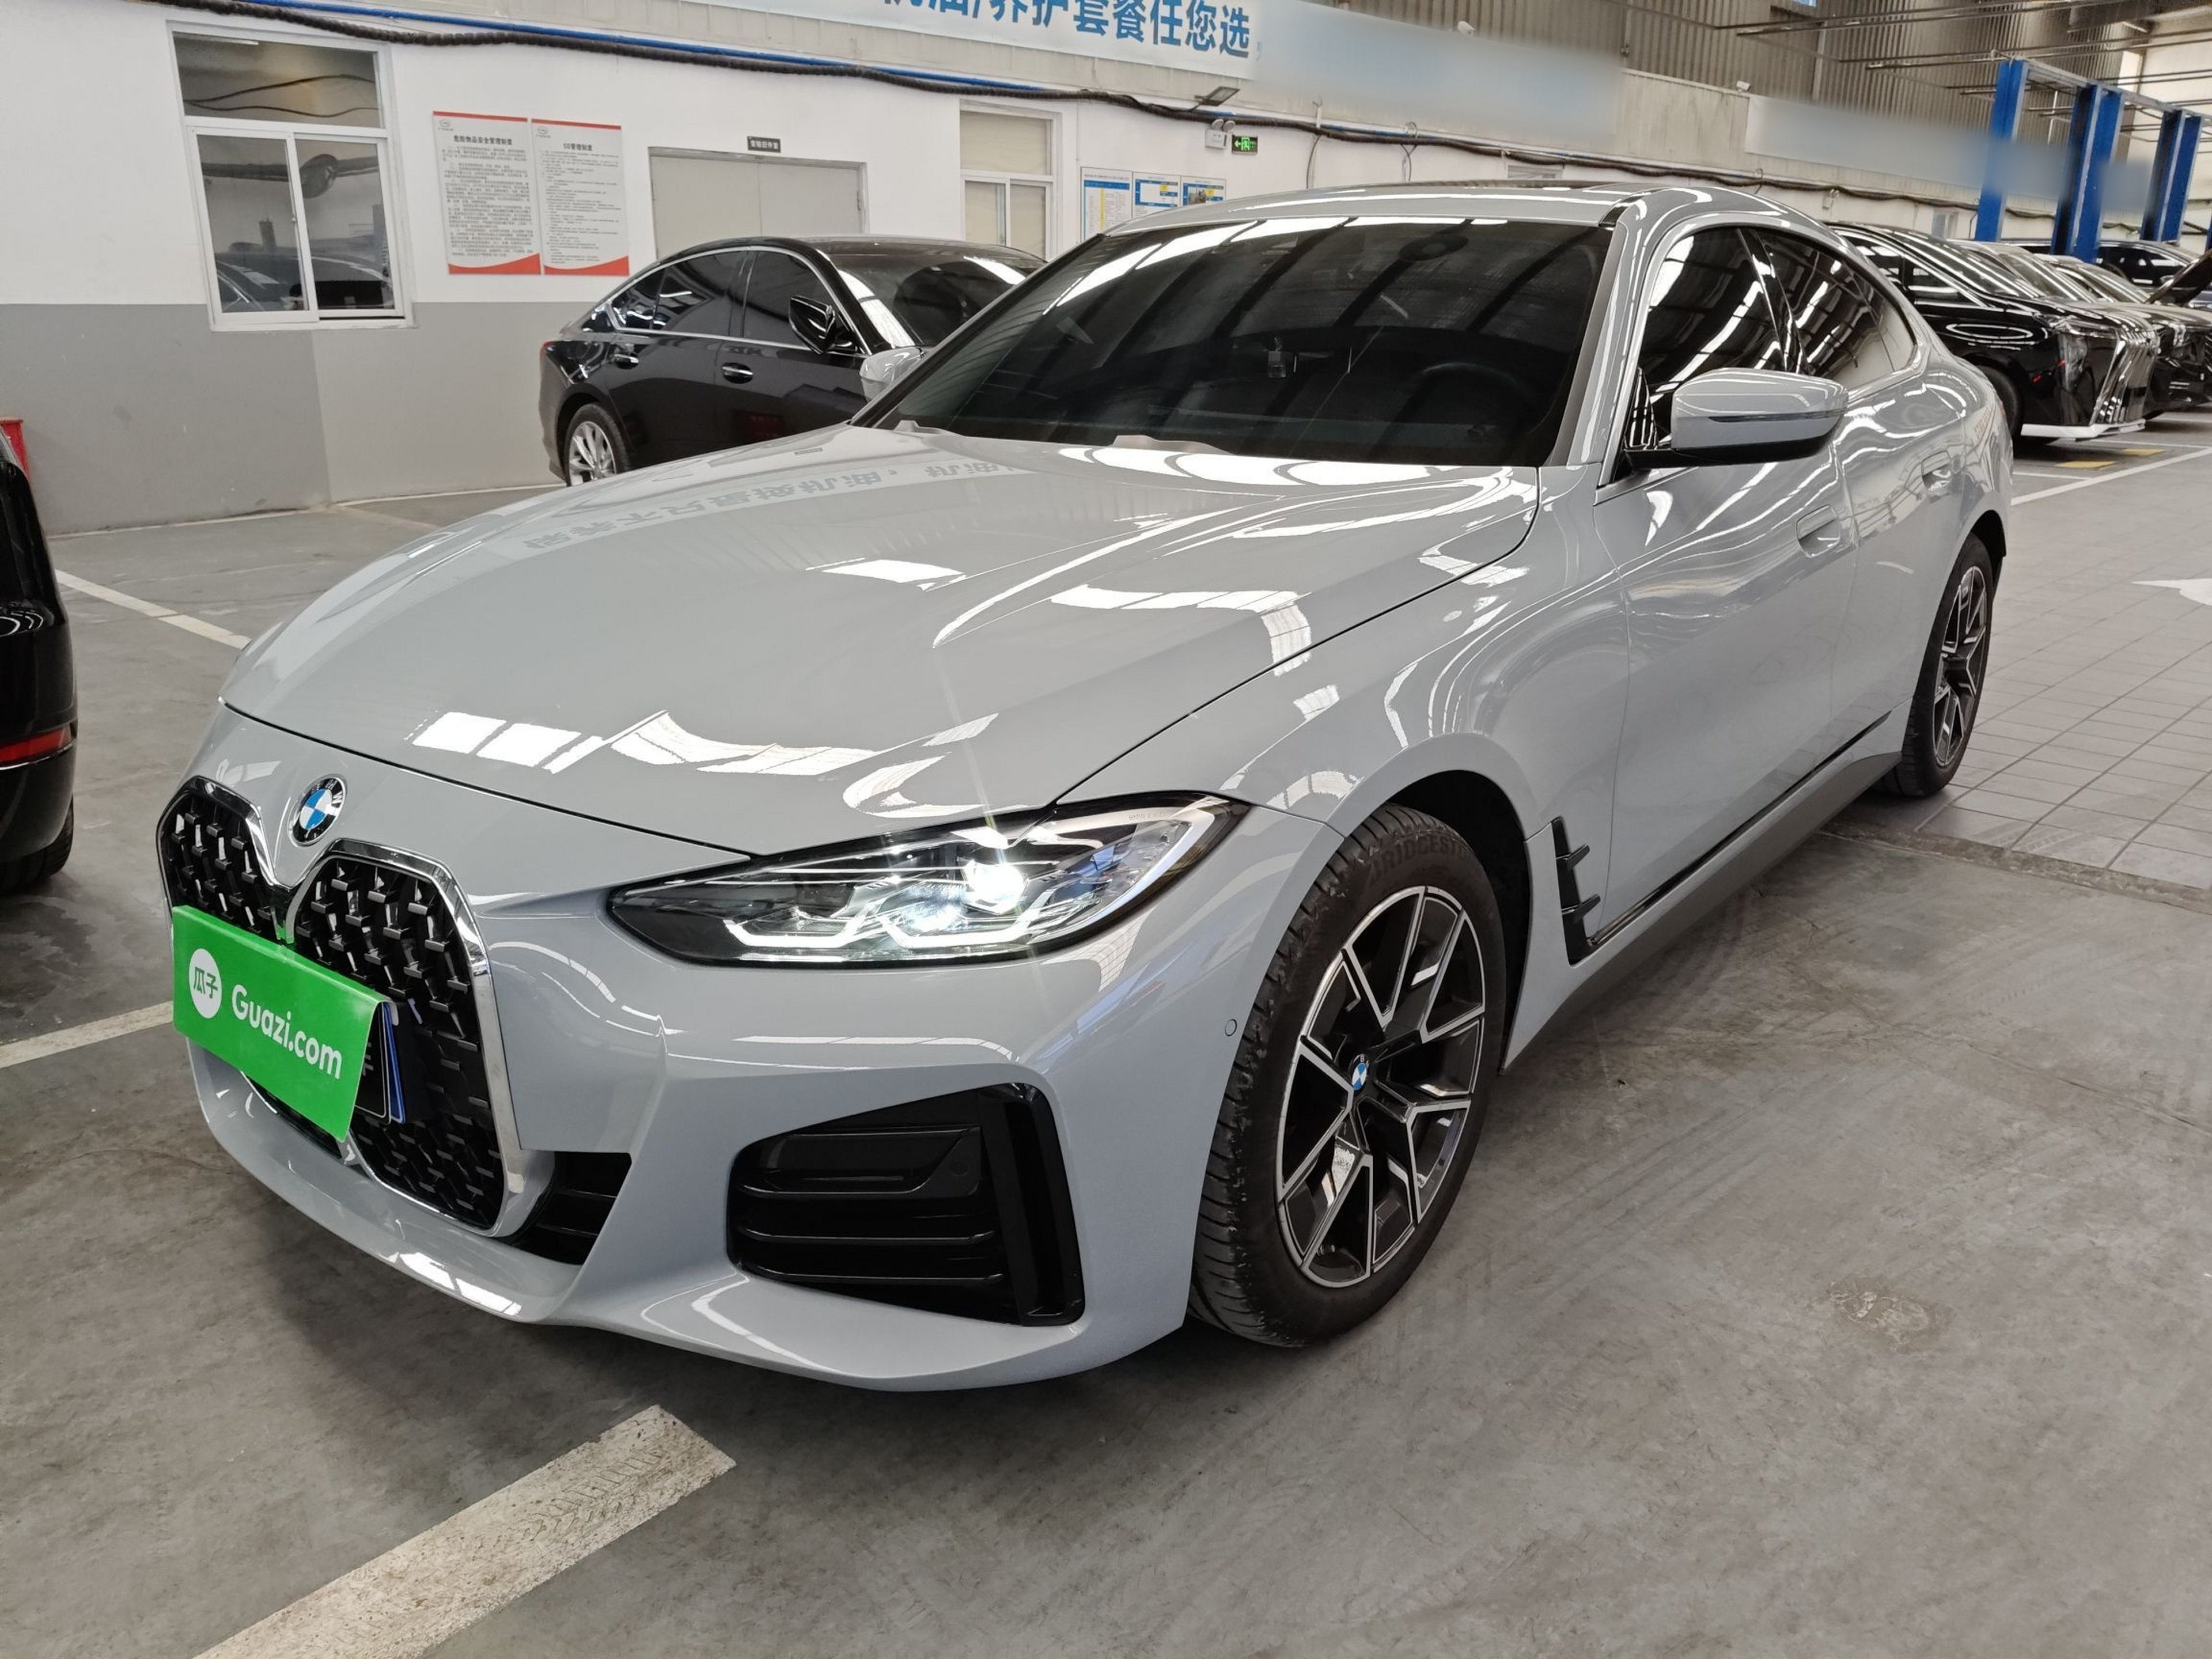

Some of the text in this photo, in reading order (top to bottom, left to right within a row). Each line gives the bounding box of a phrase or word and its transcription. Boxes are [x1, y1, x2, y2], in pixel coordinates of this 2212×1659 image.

[454, 134, 512, 146] 危险物品安全管理制度
[194, 966, 218, 999] 瓜子
[232, 984, 343, 1080] Guazi.com
